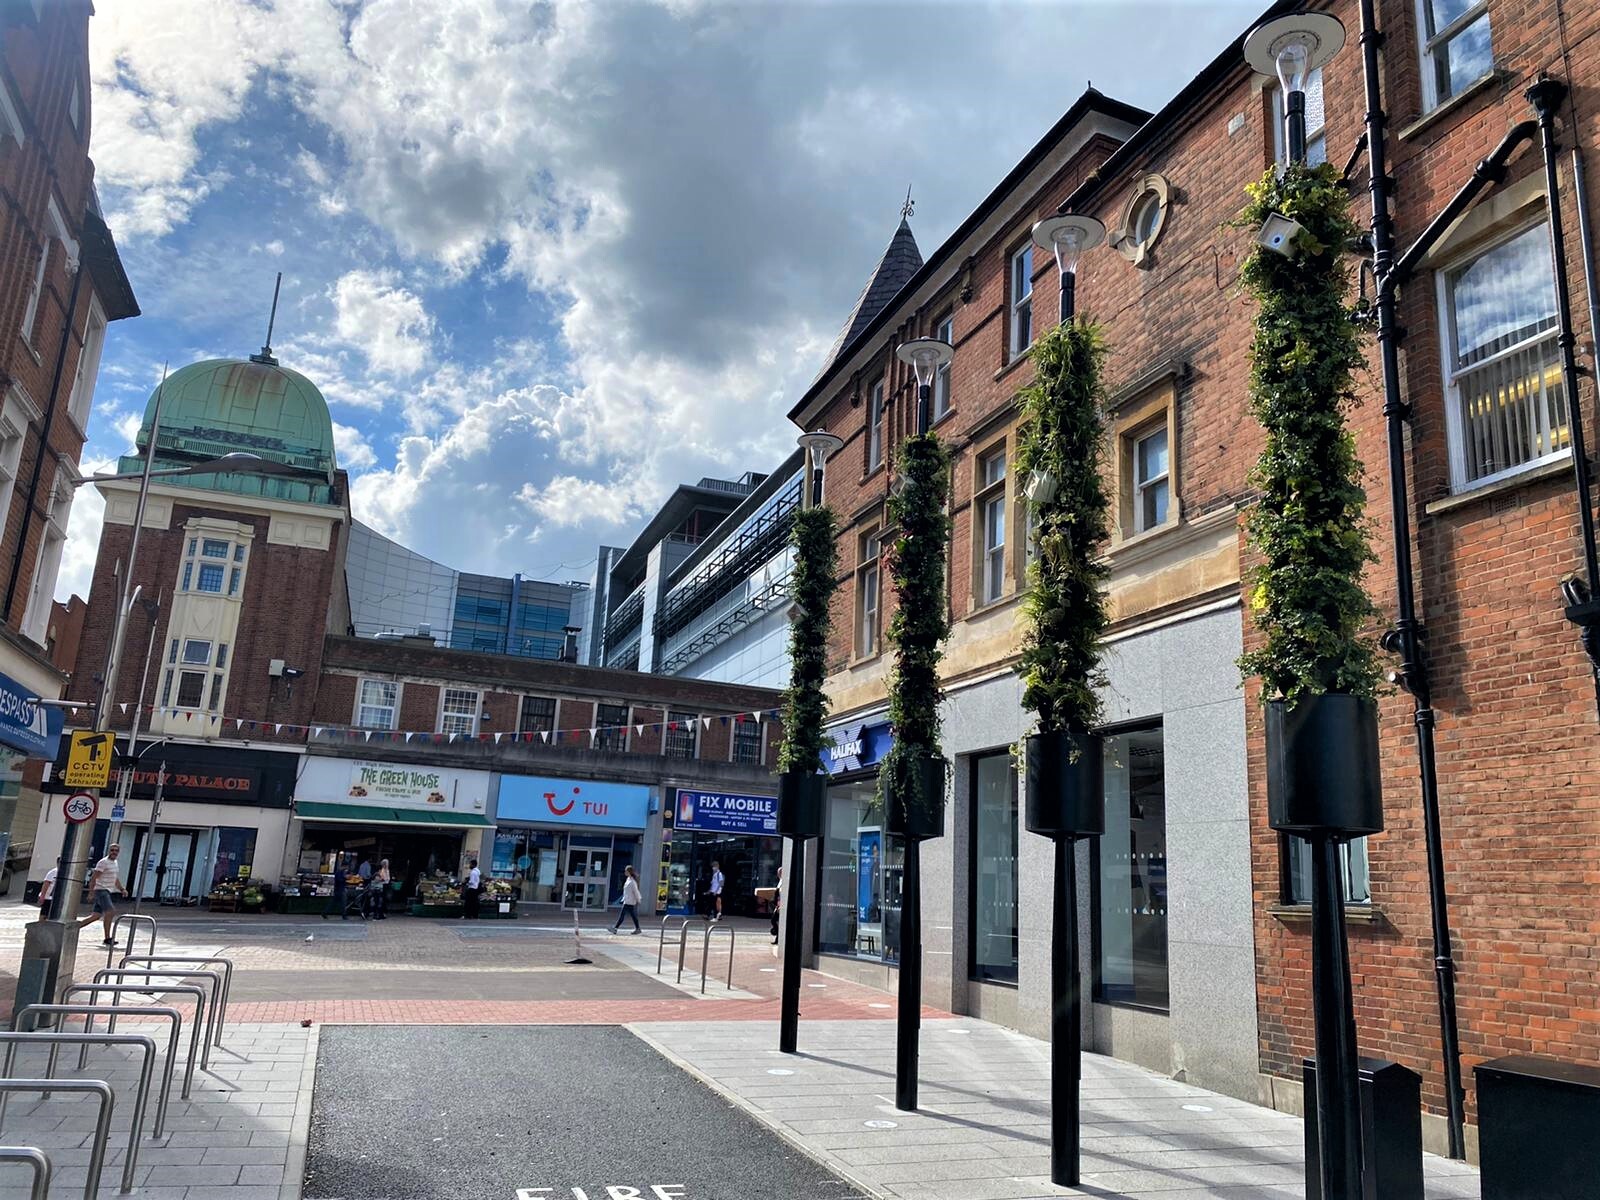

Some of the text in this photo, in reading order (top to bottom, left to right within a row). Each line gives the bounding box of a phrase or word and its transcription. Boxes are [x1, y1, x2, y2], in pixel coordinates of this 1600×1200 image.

[831, 740, 862, 760] HALIFAX
[73, 762, 105, 771] CCTV
[67, 779, 105, 787] 24hrs/day
[175, 773, 250, 791] PALACE
[360, 767, 440, 789] THE GREEN HOUSE
[583, 802, 608, 816] TUI
[699, 795, 771, 812] FIX MOBILE
